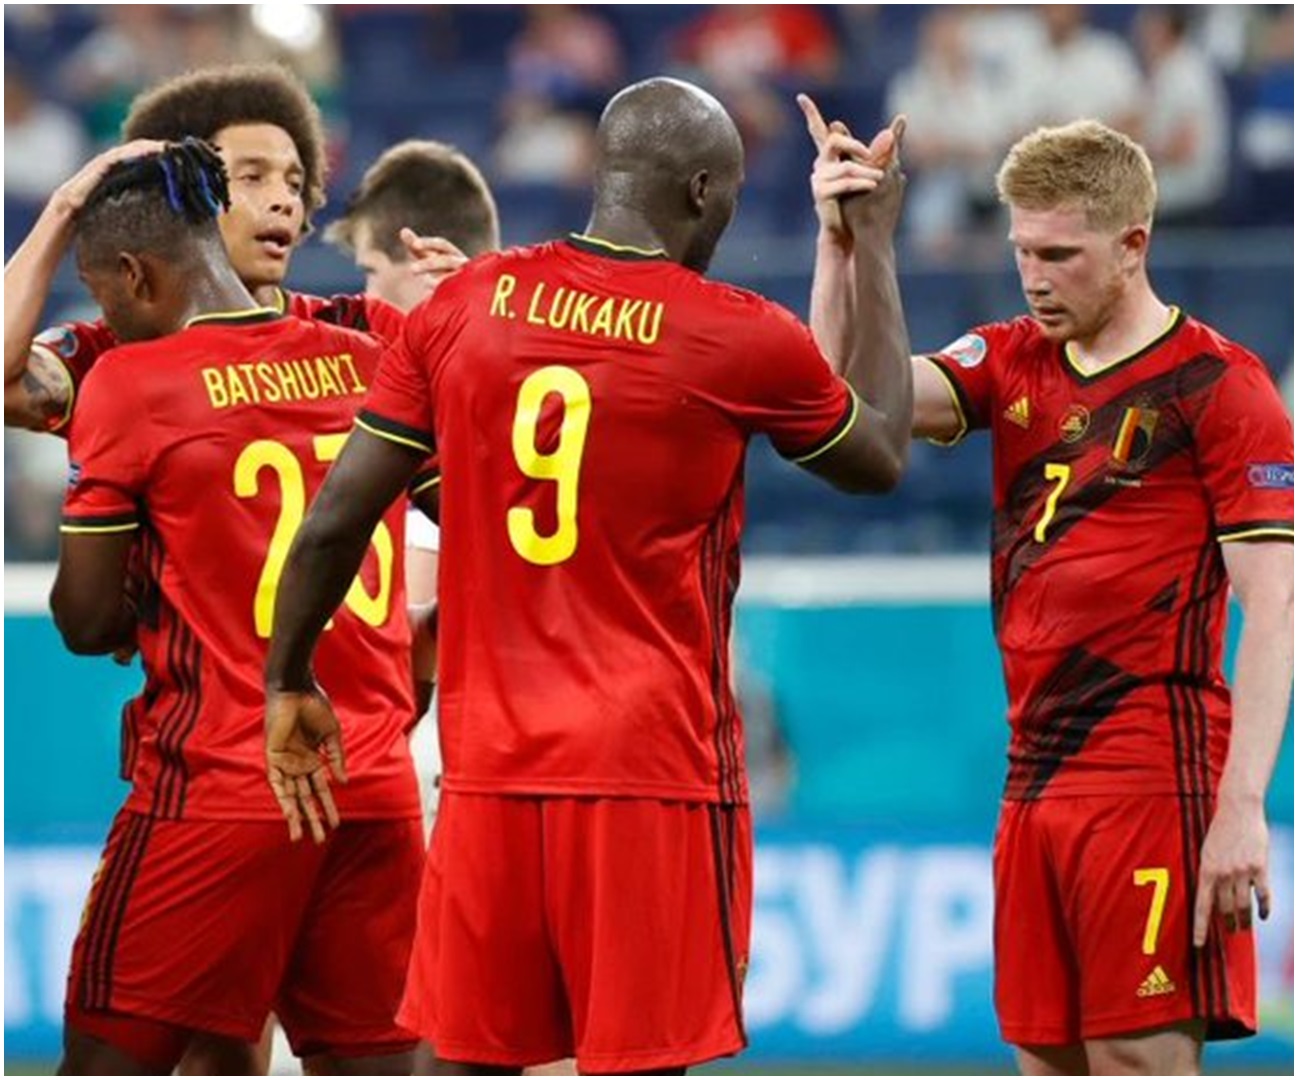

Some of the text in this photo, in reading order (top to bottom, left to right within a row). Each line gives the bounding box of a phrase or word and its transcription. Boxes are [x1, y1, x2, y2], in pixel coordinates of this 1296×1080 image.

[490, 273, 663, 345] R. LUKAKU
[202, 353, 366, 409] BATSHUAYI
[507, 365, 592, 565] 9
[1034, 463, 1070, 543] 7
[1133, 867, 1169, 955] 7
